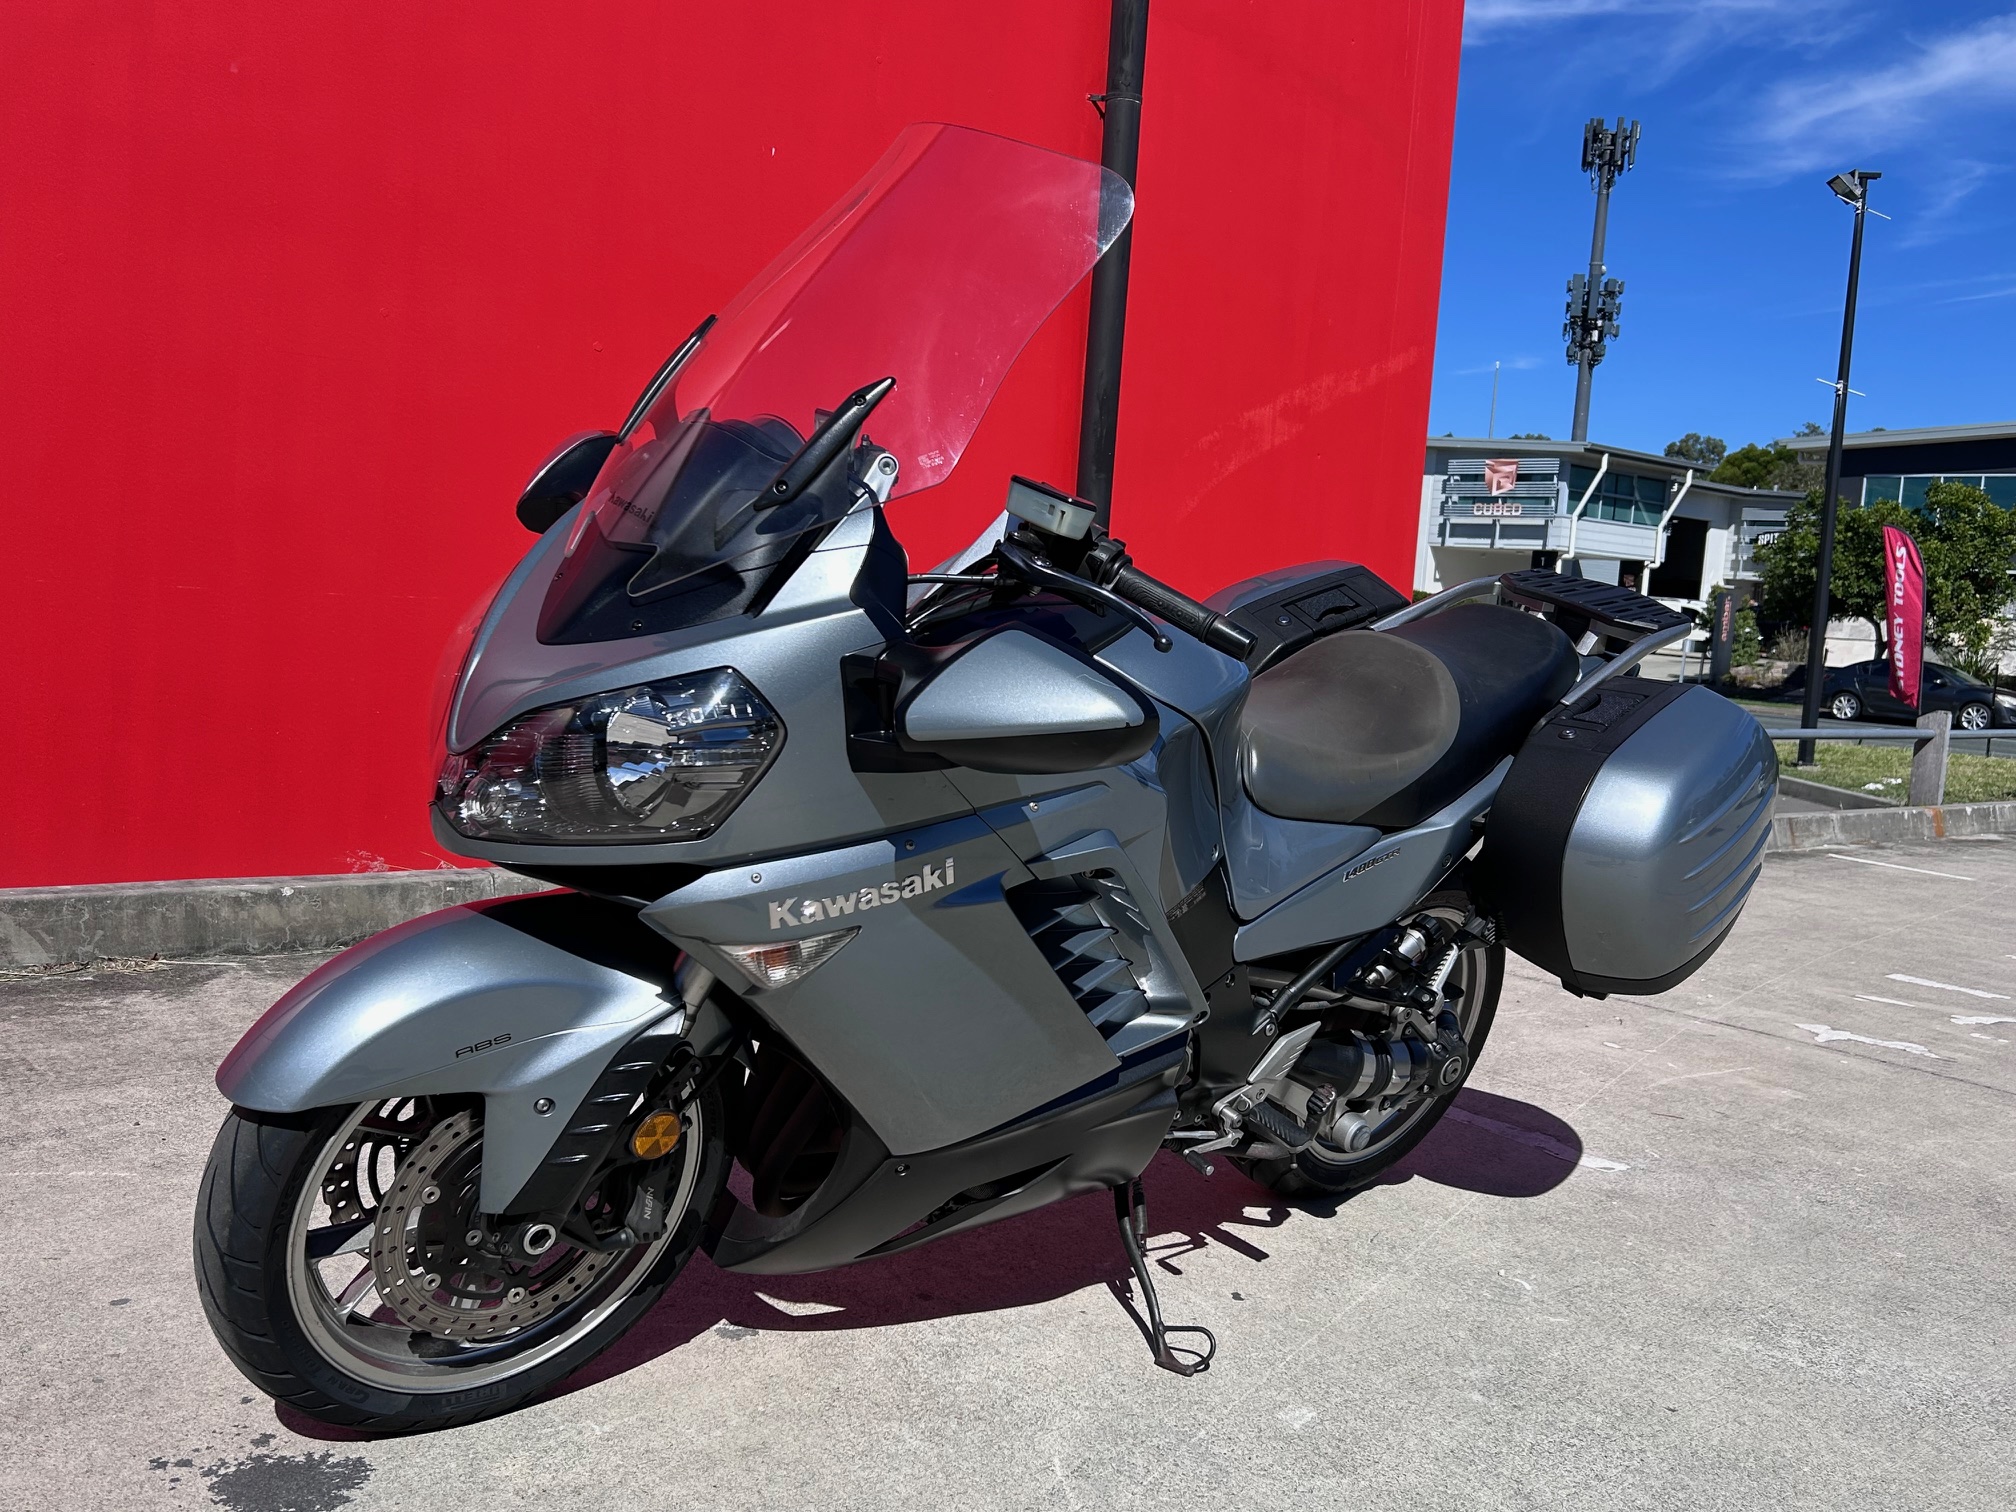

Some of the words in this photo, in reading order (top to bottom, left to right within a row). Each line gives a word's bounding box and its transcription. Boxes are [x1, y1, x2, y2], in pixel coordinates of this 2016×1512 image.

[608, 490, 655, 523] Kawasaki
[1473, 503, 1522, 516] CUBED
[1893, 546, 1907, 607] TOOLS
[768, 857, 955, 930] Kawasaki
[455, 1033, 512, 1058] ABS
